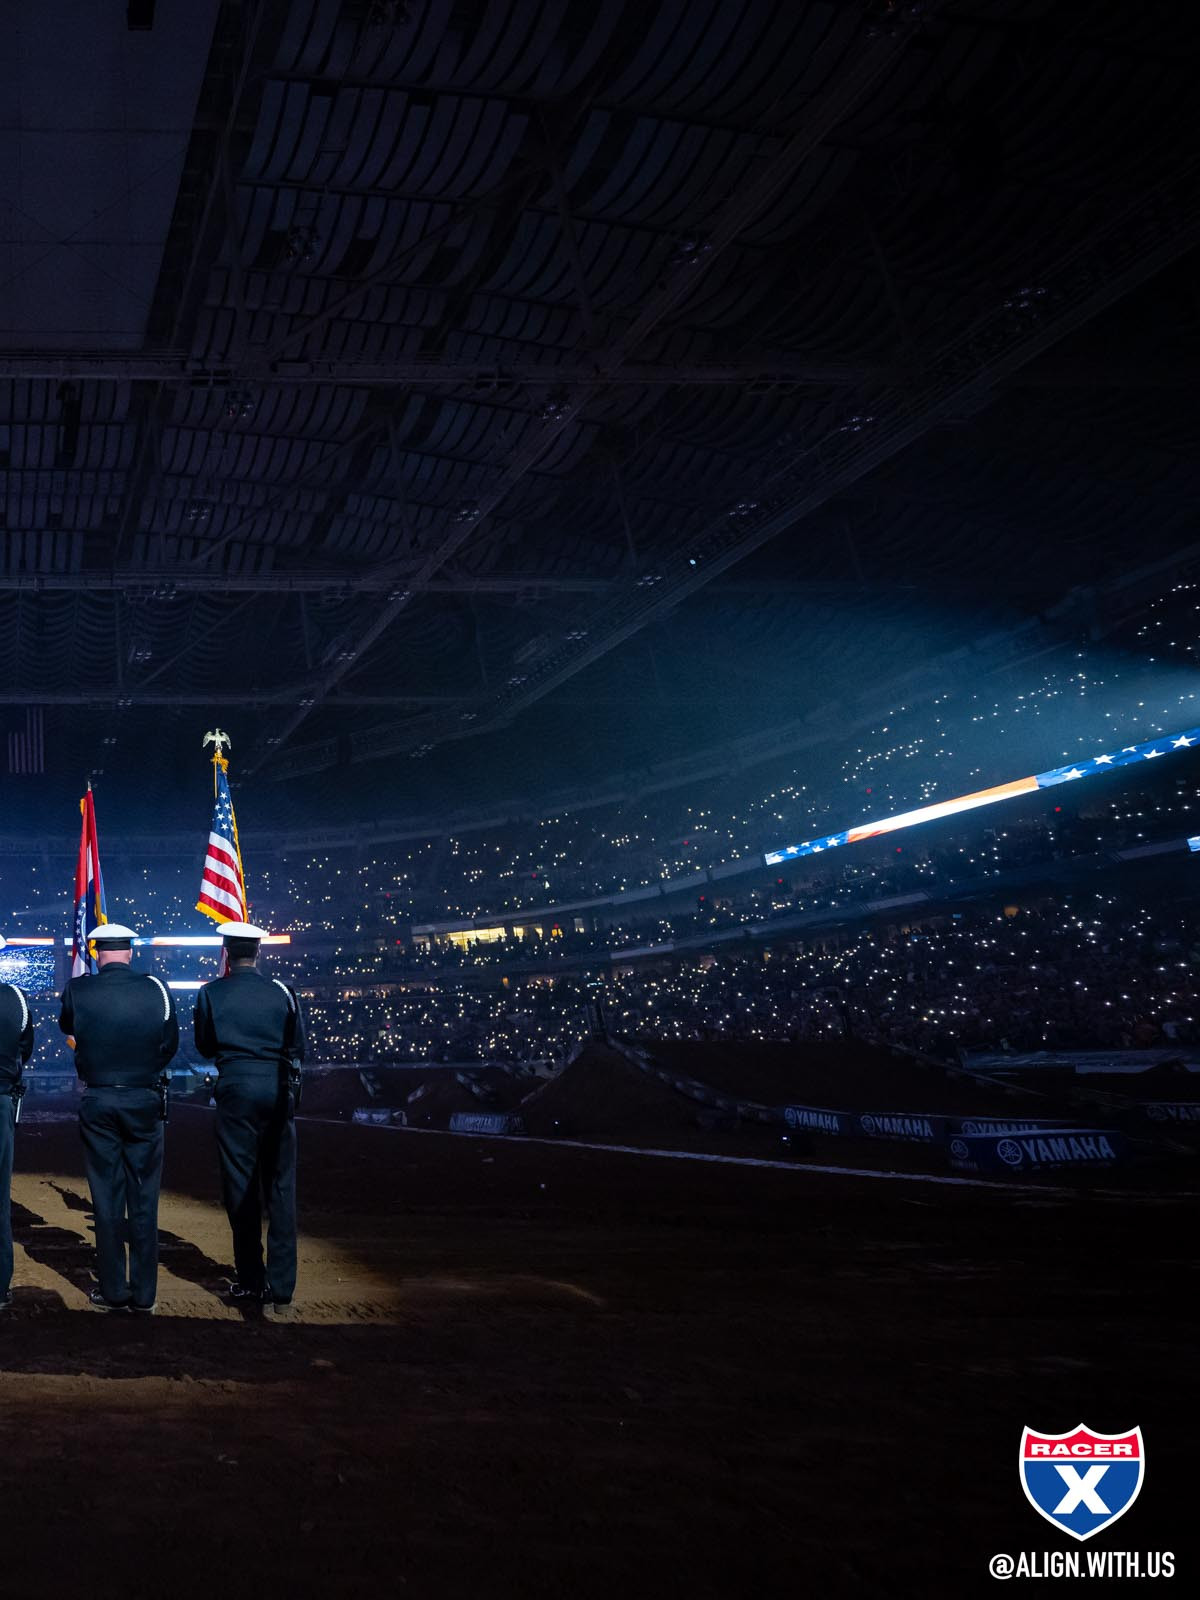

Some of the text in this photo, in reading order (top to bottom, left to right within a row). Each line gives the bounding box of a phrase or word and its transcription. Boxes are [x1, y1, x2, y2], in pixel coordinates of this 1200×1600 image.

[796, 1110, 840, 1132] YAMAHA
[874, 1116, 934, 1137] YAMAHA
[1021, 1135, 1116, 1163] YAMAHA
